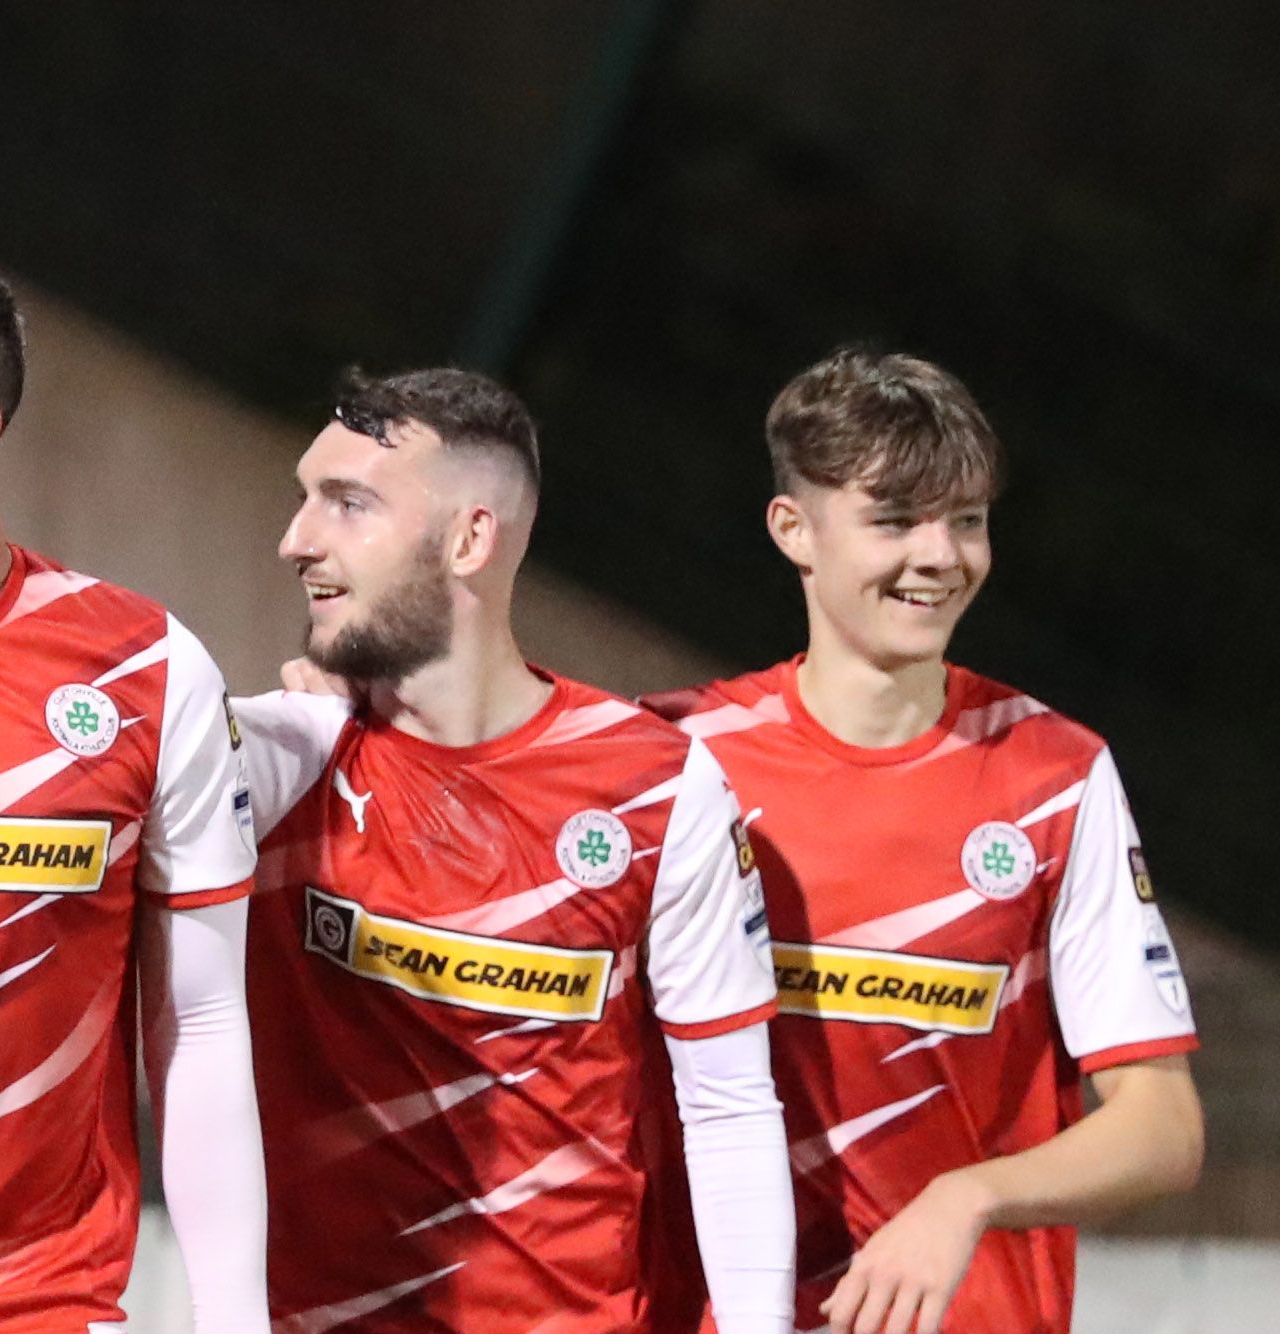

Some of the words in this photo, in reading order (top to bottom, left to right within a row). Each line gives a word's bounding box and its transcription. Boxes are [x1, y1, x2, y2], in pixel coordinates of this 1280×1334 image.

[364, 935, 449, 976] SEAN
[454, 960, 592, 997] GRAHAM
[856, 975, 989, 1010] GRAHAM
